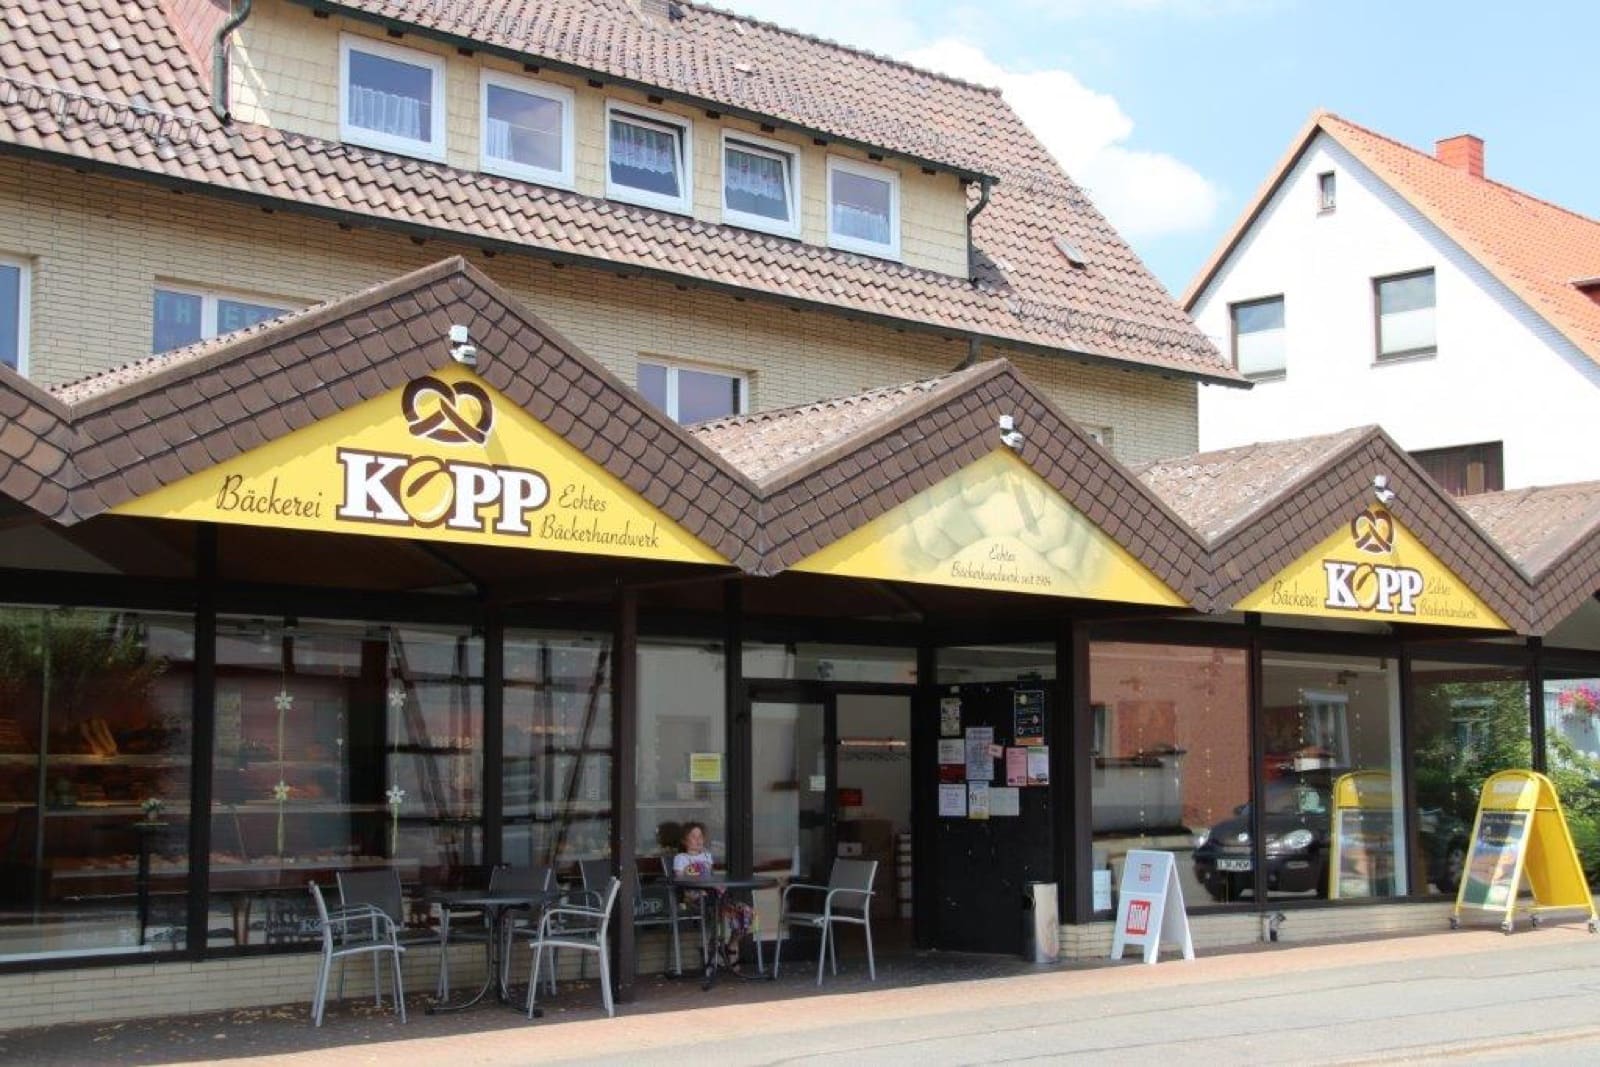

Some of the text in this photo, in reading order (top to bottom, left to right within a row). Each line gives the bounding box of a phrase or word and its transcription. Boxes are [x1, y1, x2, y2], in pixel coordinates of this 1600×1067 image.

[216, 447, 550, 537] Bäckerei KOPP
[558, 484, 607, 512] Echtes
[540, 513, 659, 548] Bäckerhandwerk
[1271, 559, 1424, 615] Bäckerei KOPP
